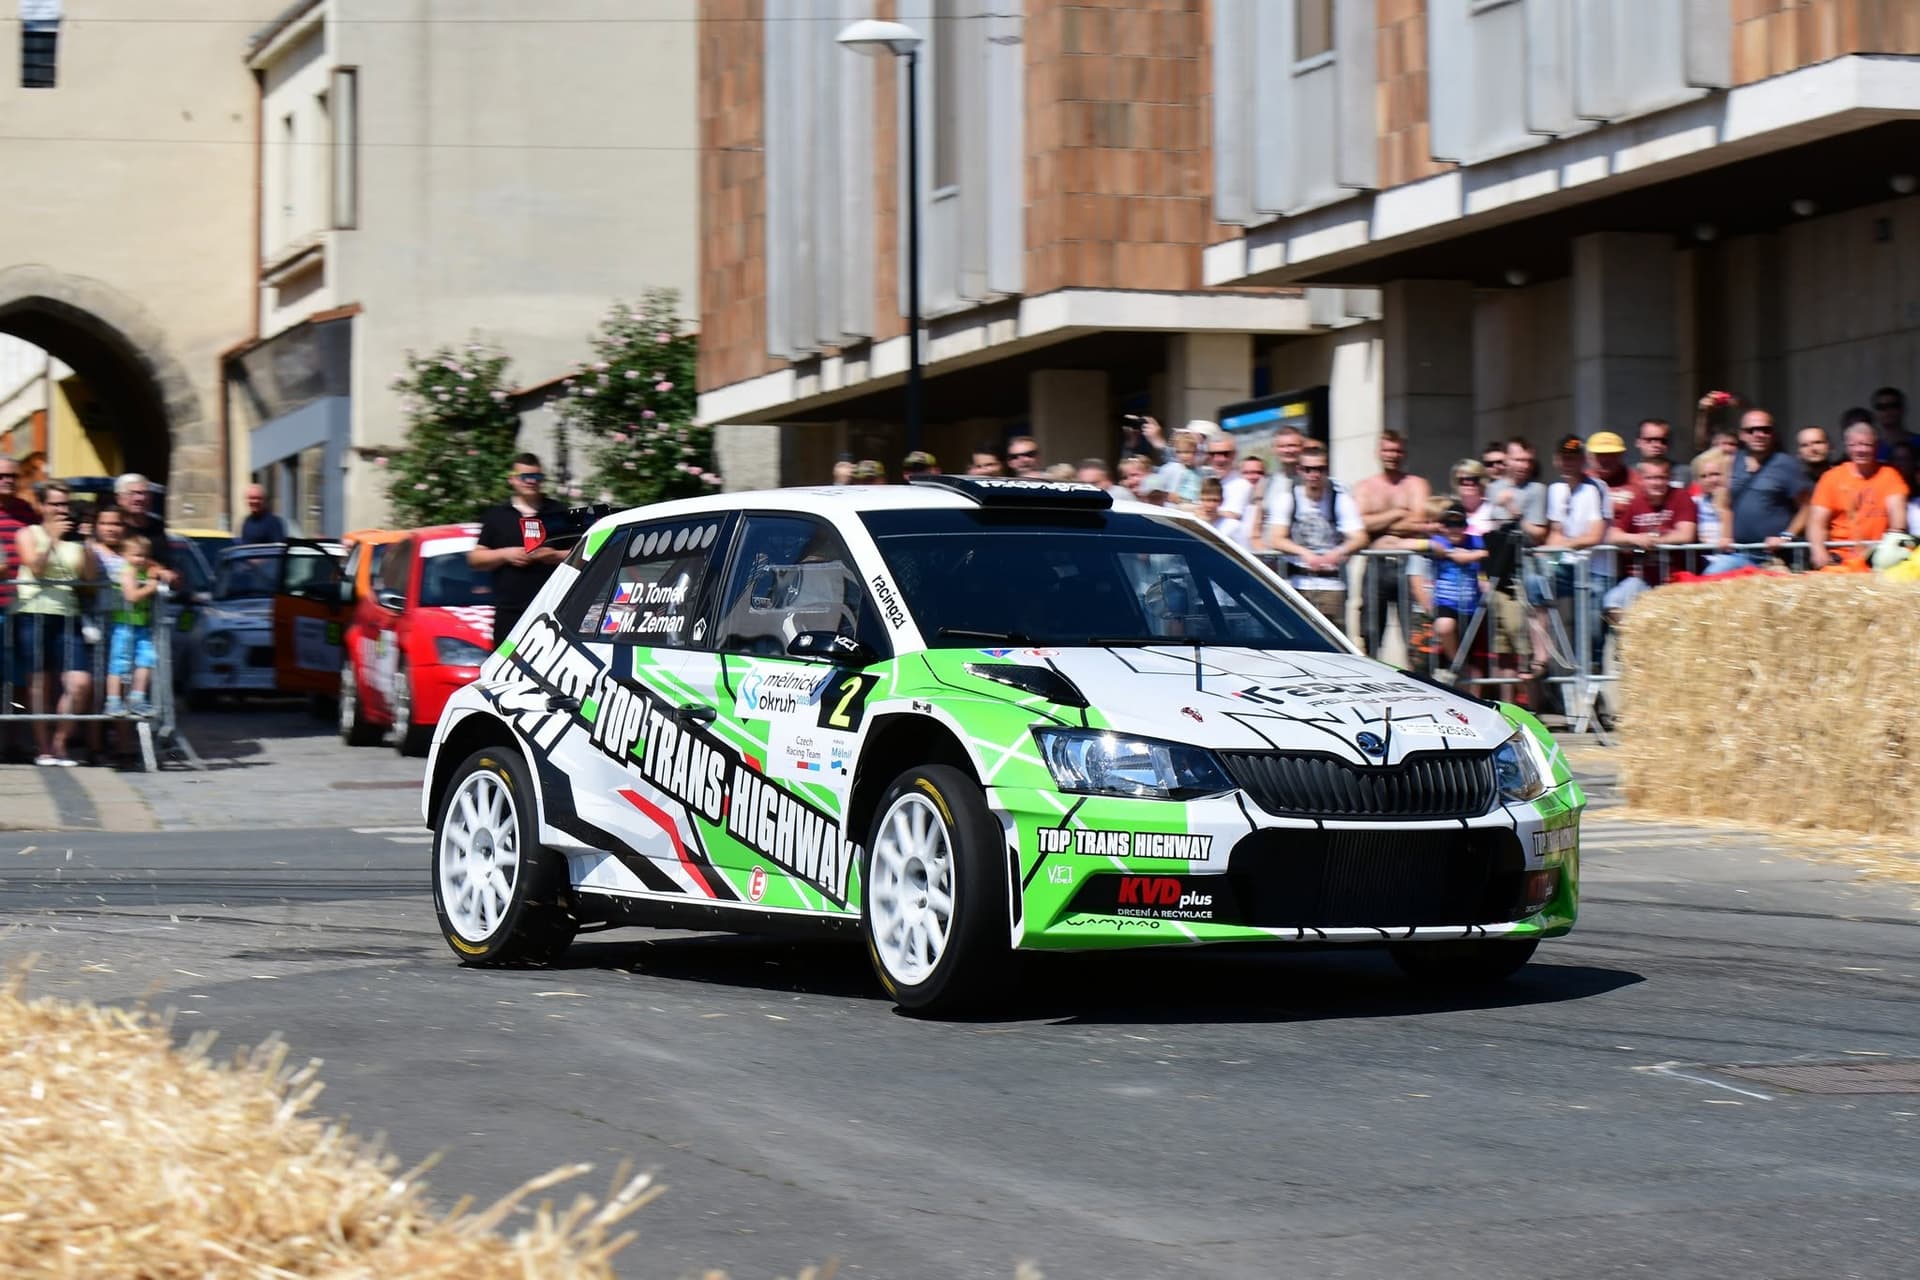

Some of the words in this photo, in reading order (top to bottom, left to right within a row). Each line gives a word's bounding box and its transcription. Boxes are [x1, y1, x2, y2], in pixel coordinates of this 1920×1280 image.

[630, 582, 645, 604] D.
[645, 582, 689, 604] Tomek
[871, 574, 907, 630] racing21
[619, 611, 637, 633] M.
[638, 611, 685, 633] Zeman
[759, 690, 796, 713] okruh
[829, 676, 863, 728] 2
[786, 745, 805, 759] Racing
[806, 748, 821, 759] Team
[795, 735, 814, 747] Czech
[594, 677, 643, 759] TOP
[644, 708, 727, 821] TRANS
[729, 764, 857, 902] HIGHWAY
[1038, 828, 1071, 852] TOP
[1075, 830, 1130, 856] TRANS
[1134, 832, 1213, 860] HIGHWAY
[1117, 876, 1182, 905] KVD
[1179, 891, 1213, 908] plus
[1161, 910, 1213, 918] RECYKLACE
